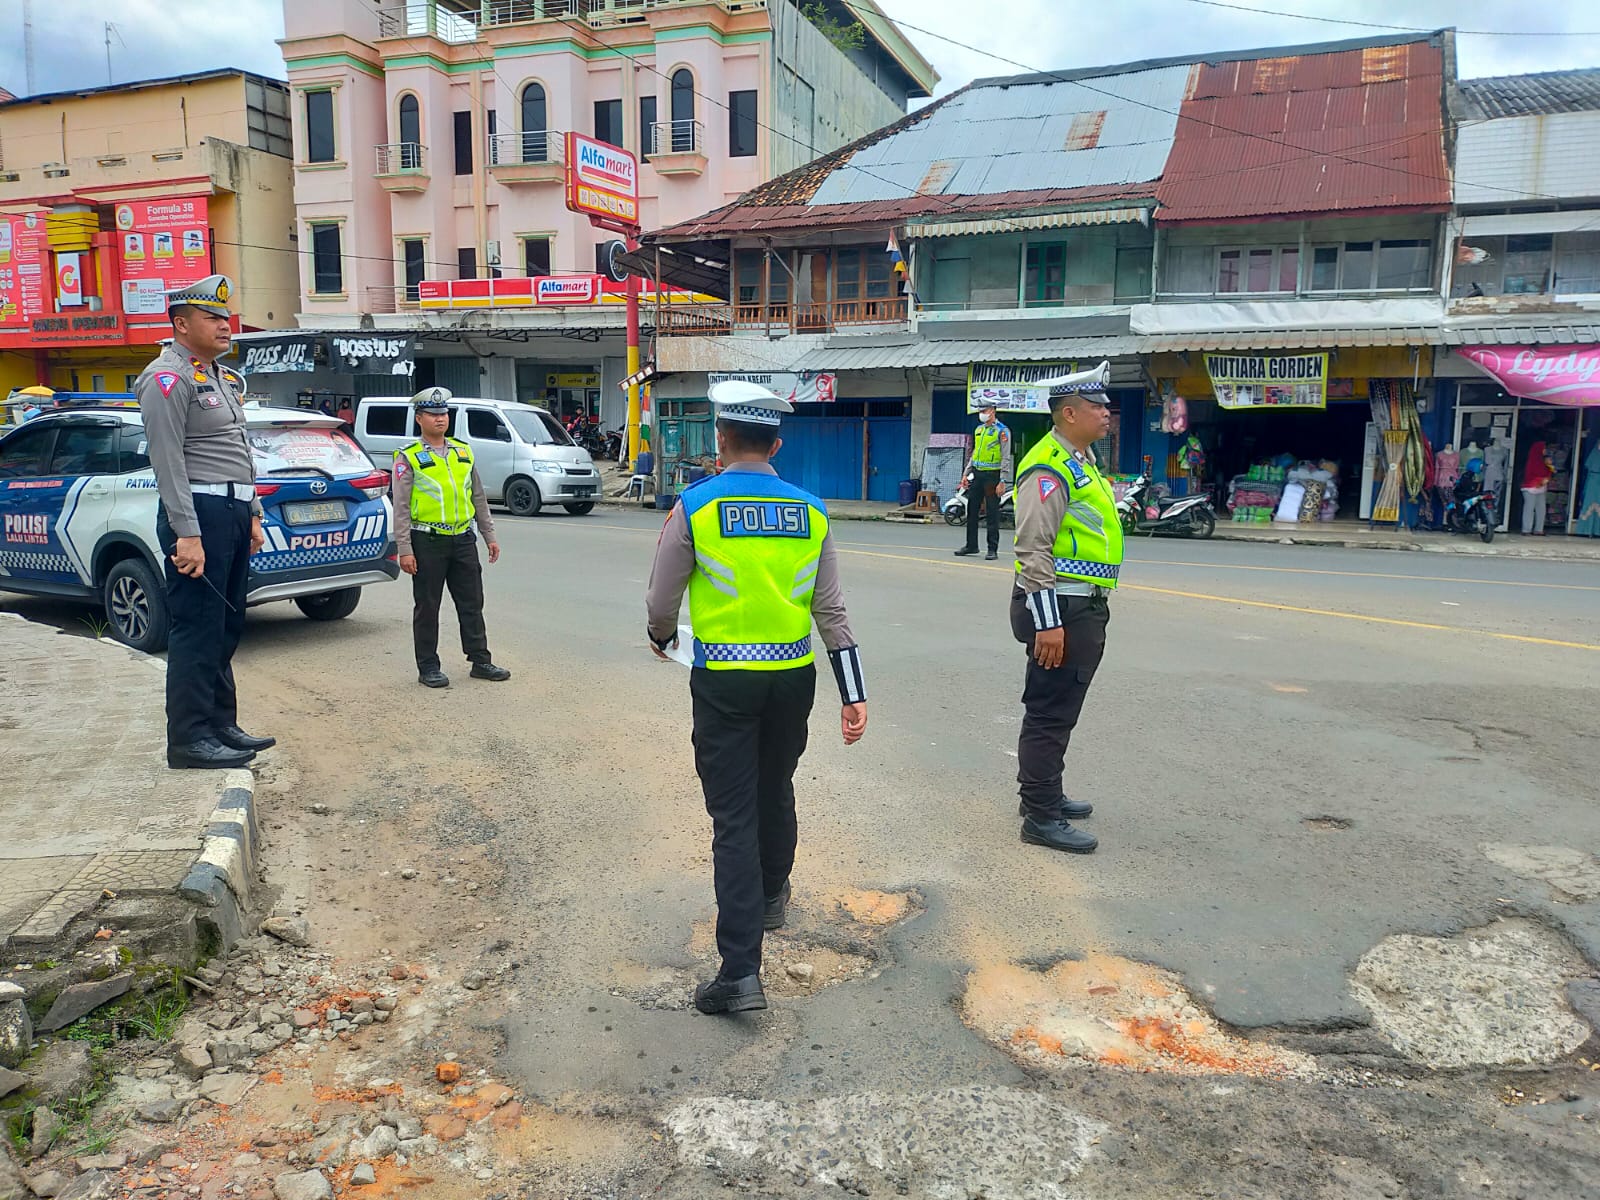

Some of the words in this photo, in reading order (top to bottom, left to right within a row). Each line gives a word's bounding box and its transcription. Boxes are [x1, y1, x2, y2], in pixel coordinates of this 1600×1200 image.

[581, 145, 632, 177] Alfamart
[147, 203, 180, 214] Formula
[182, 202, 194, 212] 3B
[541, 279, 588, 292] Alfamart
[245, 344, 283, 365] BOSS
[283, 343, 307, 364] JUS
[971, 364, 1017, 384] MUTIARA
[1208, 357, 1266, 378] MUTIARA
[1269, 356, 1322, 378] GORDEN
[747, 375, 772, 384] KREATIF
[126, 478, 159, 488] PATWA
[5, 514, 48, 534] POLISI
[725, 506, 807, 533] POLISI
[6, 533, 23, 543] LALU
[24, 534, 49, 545] LINTAS
[290, 531, 349, 550] POLISI
